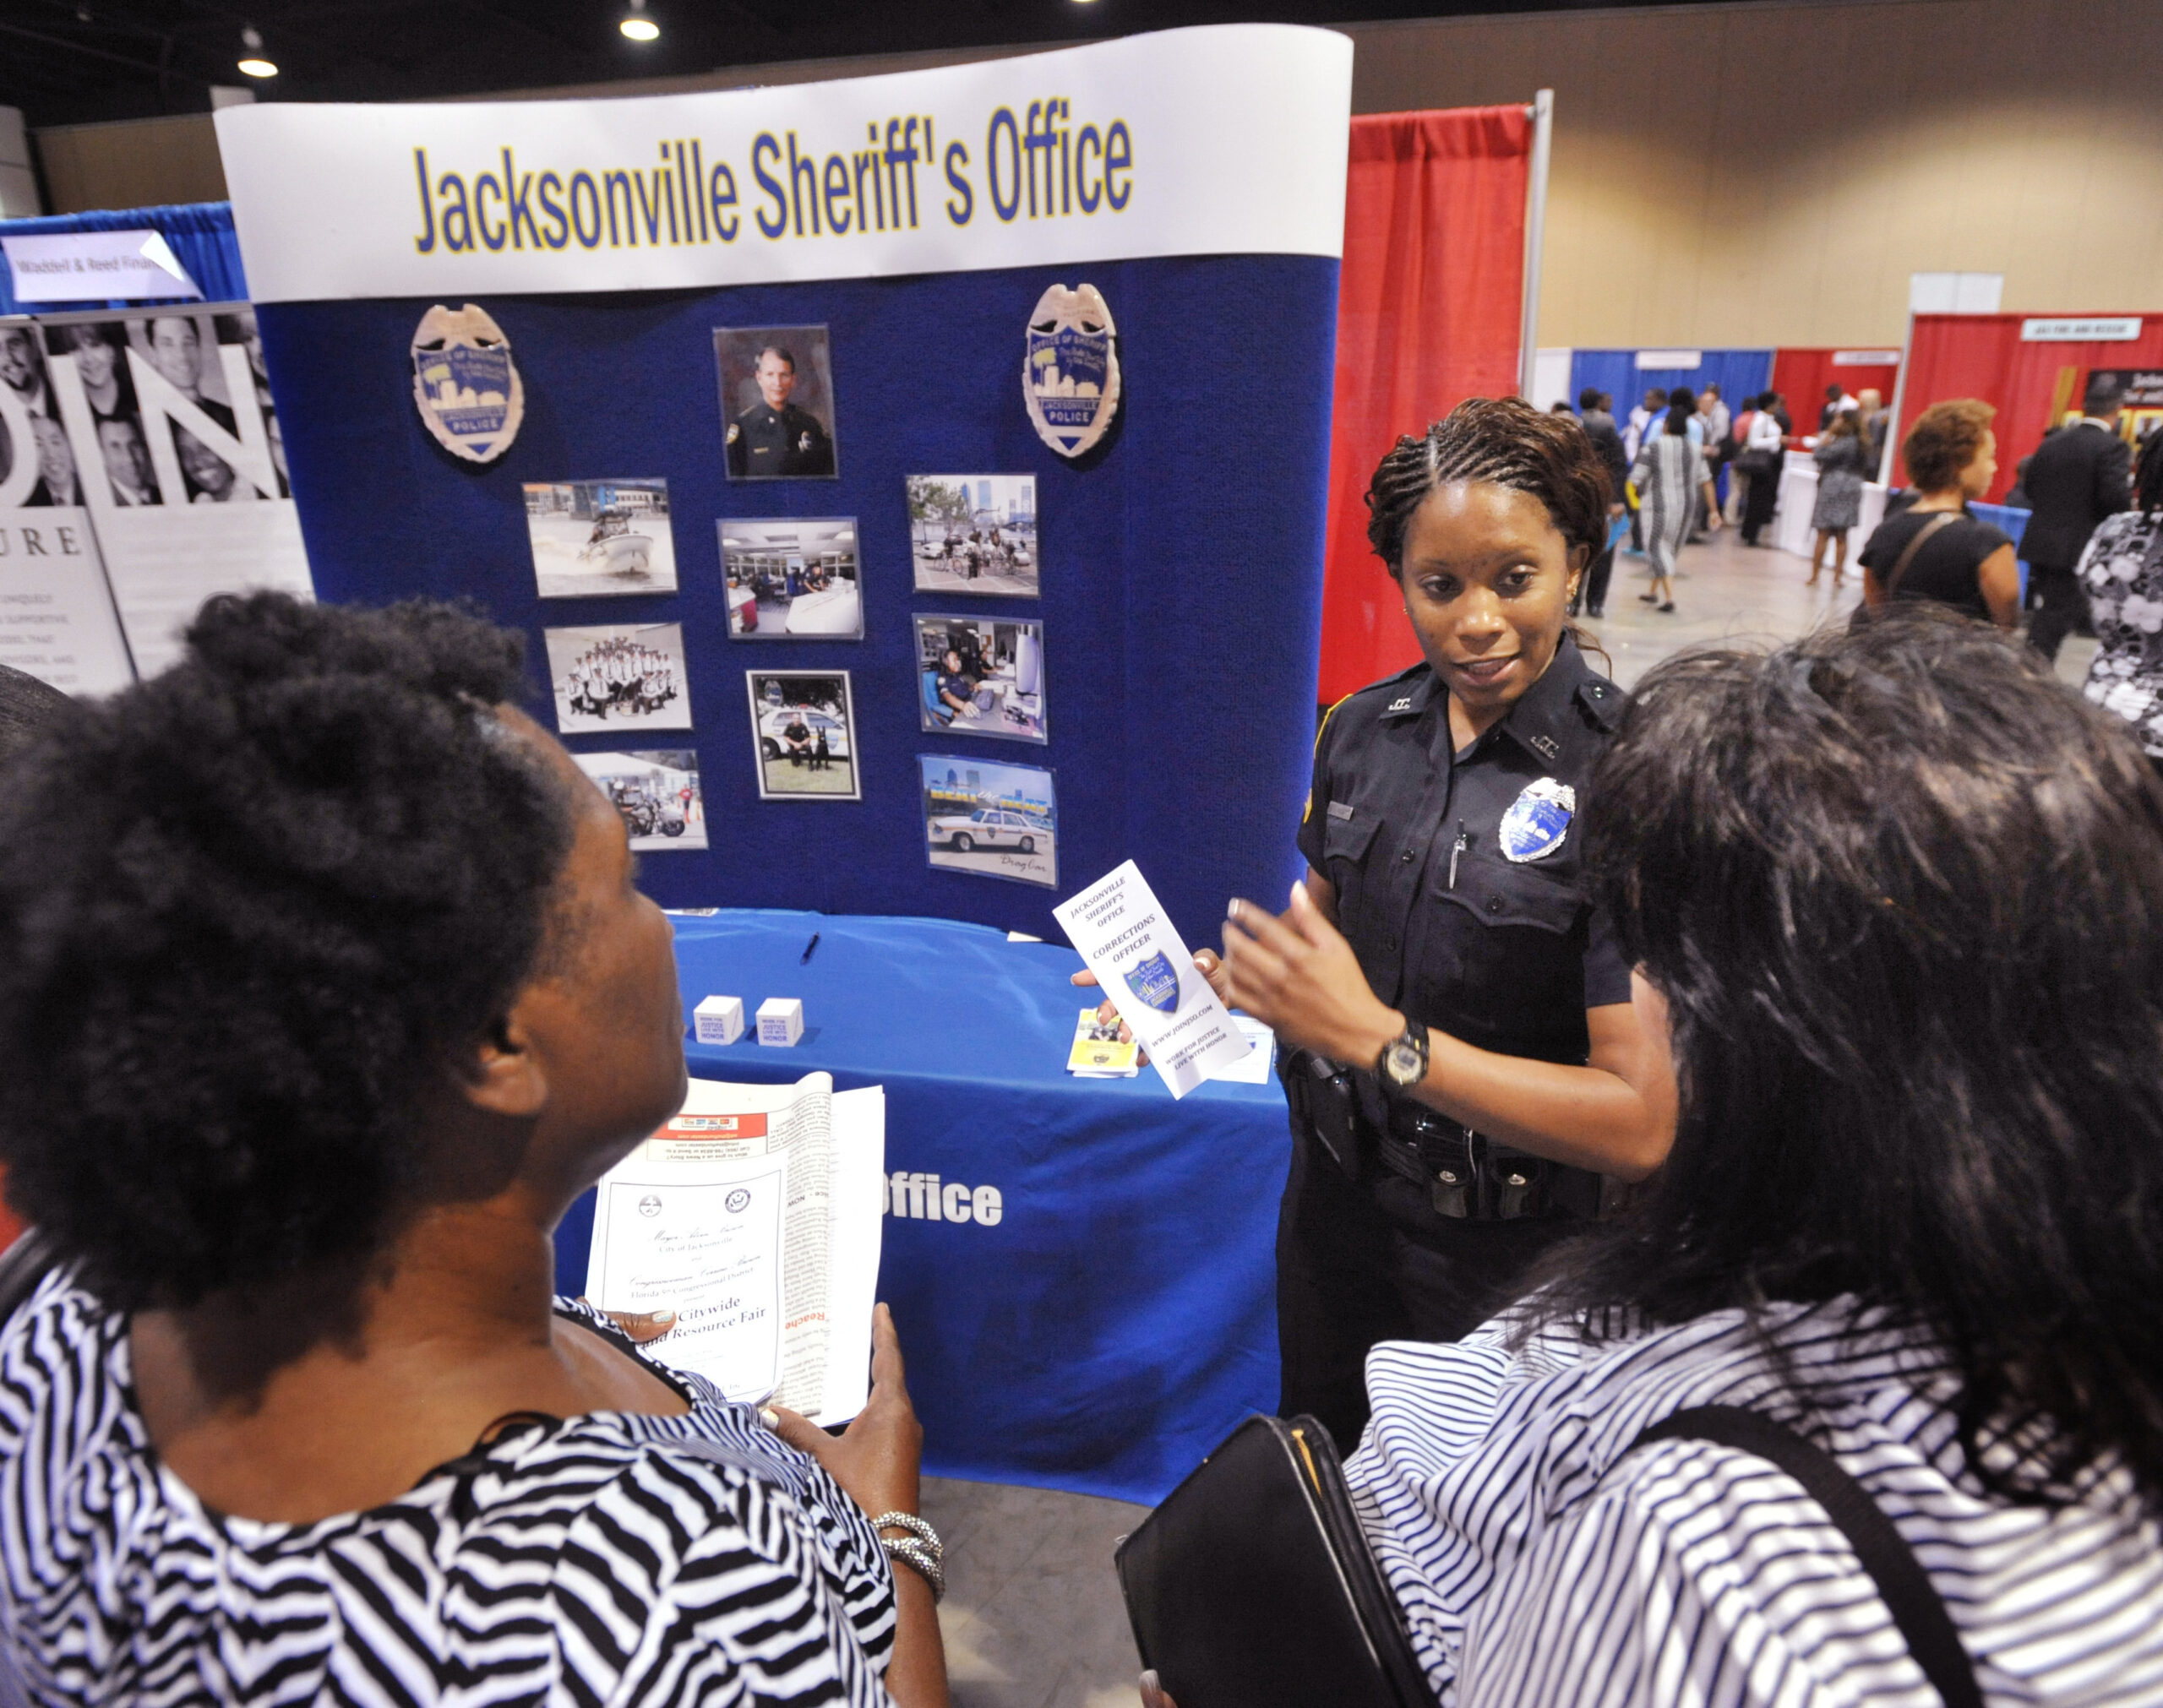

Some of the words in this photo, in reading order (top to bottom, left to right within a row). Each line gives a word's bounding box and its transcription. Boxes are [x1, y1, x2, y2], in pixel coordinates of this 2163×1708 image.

[412, 139, 740, 254] Jacksonville
[750, 116, 975, 240] Sheriff's
[986, 95, 1133, 223] Office
[453, 417, 497, 431] POLICE
[1049, 411, 1089, 422] POLICE
[1071, 876, 1125, 919] JACKSONVILLE
[1085, 892, 1125, 922] SHERIFF'S
[1098, 906, 1125, 927] OFFICE
[1092, 913, 1155, 960] CORRECTIONS
[1113, 933, 1151, 963] OFFICER
[1165, 1049, 1184, 1065] WORK
[1185, 1042, 1197, 1053] FOR
[1197, 1025, 1220, 1045] JUSTICE
[1174, 1058, 1188, 1070] LIVE
[1188, 1046, 1205, 1061] WITH
[1206, 1033, 1227, 1049] HONOR
[787, 1194, 805, 1208] NOW
[882, 1171, 1003, 1227] ffice
[673, 1317, 736, 1339] Resource
[740, 1307, 766, 1324] Fair
[678, 1297, 741, 1322] Citywide
[785, 1312, 825, 1330] Reache
